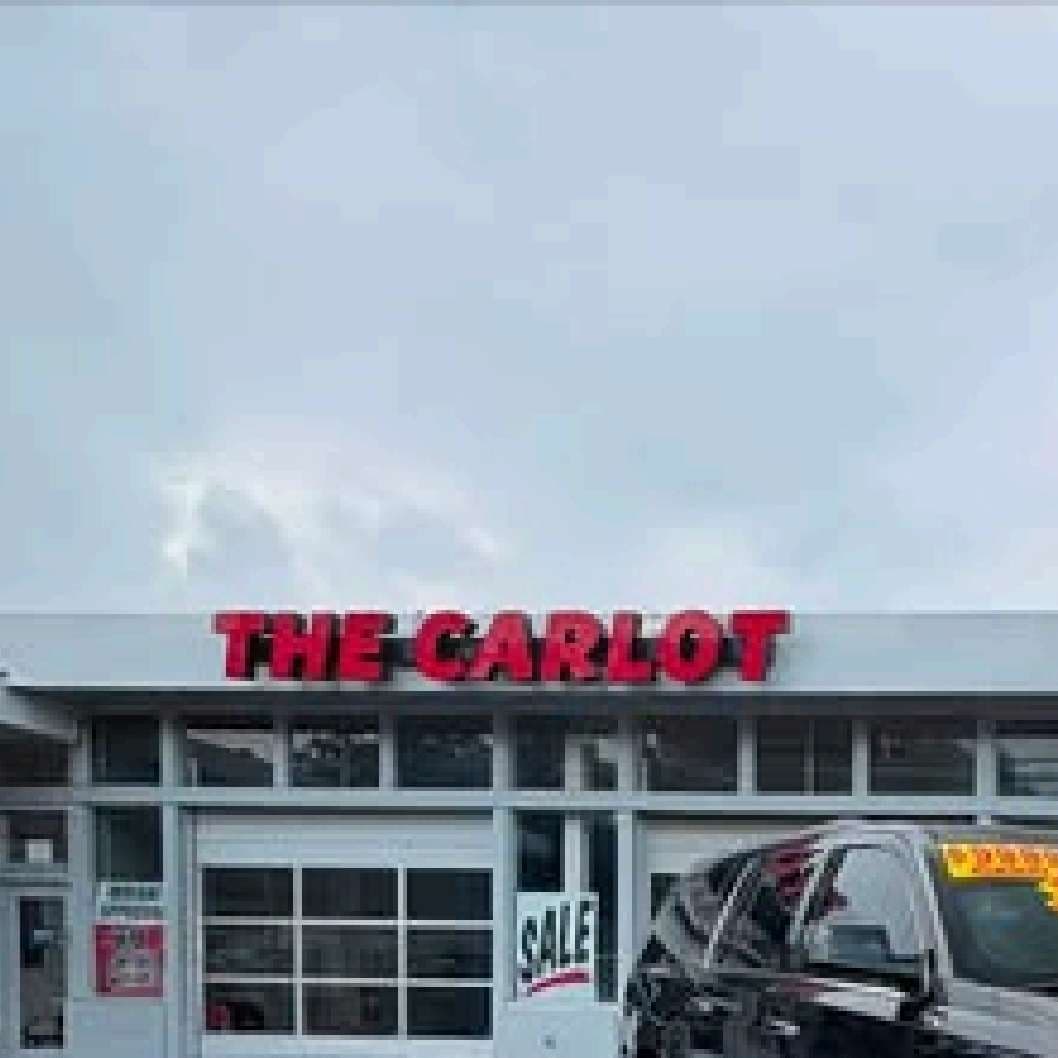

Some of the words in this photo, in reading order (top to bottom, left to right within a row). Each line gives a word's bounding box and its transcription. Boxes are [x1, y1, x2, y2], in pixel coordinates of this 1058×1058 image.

[212, 609, 392, 682] THE
[413, 608, 790, 684] CARLOT
[520, 900, 594, 984] SALE
